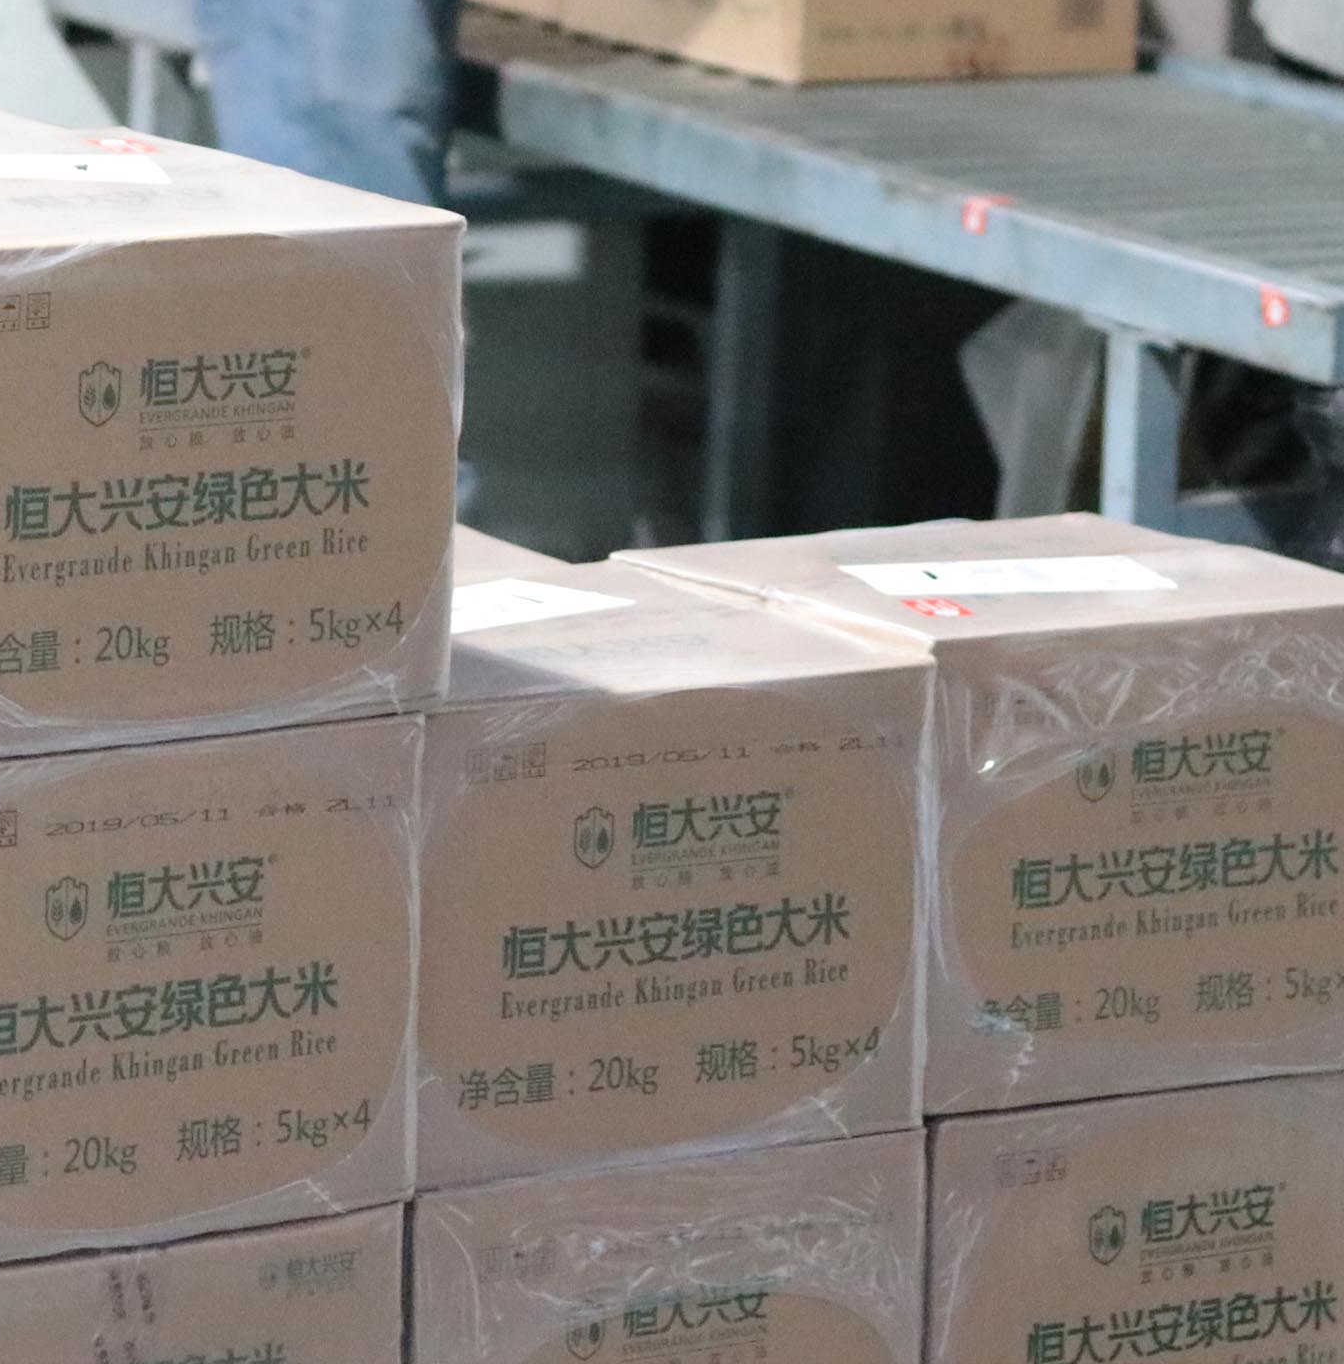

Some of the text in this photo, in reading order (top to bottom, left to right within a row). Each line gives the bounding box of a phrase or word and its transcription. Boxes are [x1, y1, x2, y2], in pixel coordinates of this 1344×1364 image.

[138, 348, 298, 408] 恒大兴安
[4, 458, 372, 542] 恒大兴安绿色大米
[2, 526, 369, 587] Evergrande Khingan Green Rice
[1133, 729, 1274, 784] 恒大兴安
[631, 790, 781, 848] 恒大兴安
[108, 855, 266, 920] 恒大兴安
[1012, 829, 1340, 911] 恒大兴安绿色大米
[503, 892, 851, 981] 恒大兴安绿色大米
[1011, 893, 1340, 950] Evergrande Khingan Green Rice
[500, 958, 849, 1022] Evergrande Khingan Green Rice
[112, 1046, 204, 1083] Khingan
[213, 1039, 279, 1069] Green
[291, 1030, 338, 1058] Rice
[1141, 1183, 1276, 1245] 恒大兴安
[1027, 1280, 1340, 1364] 恒大兴安绿色大米
